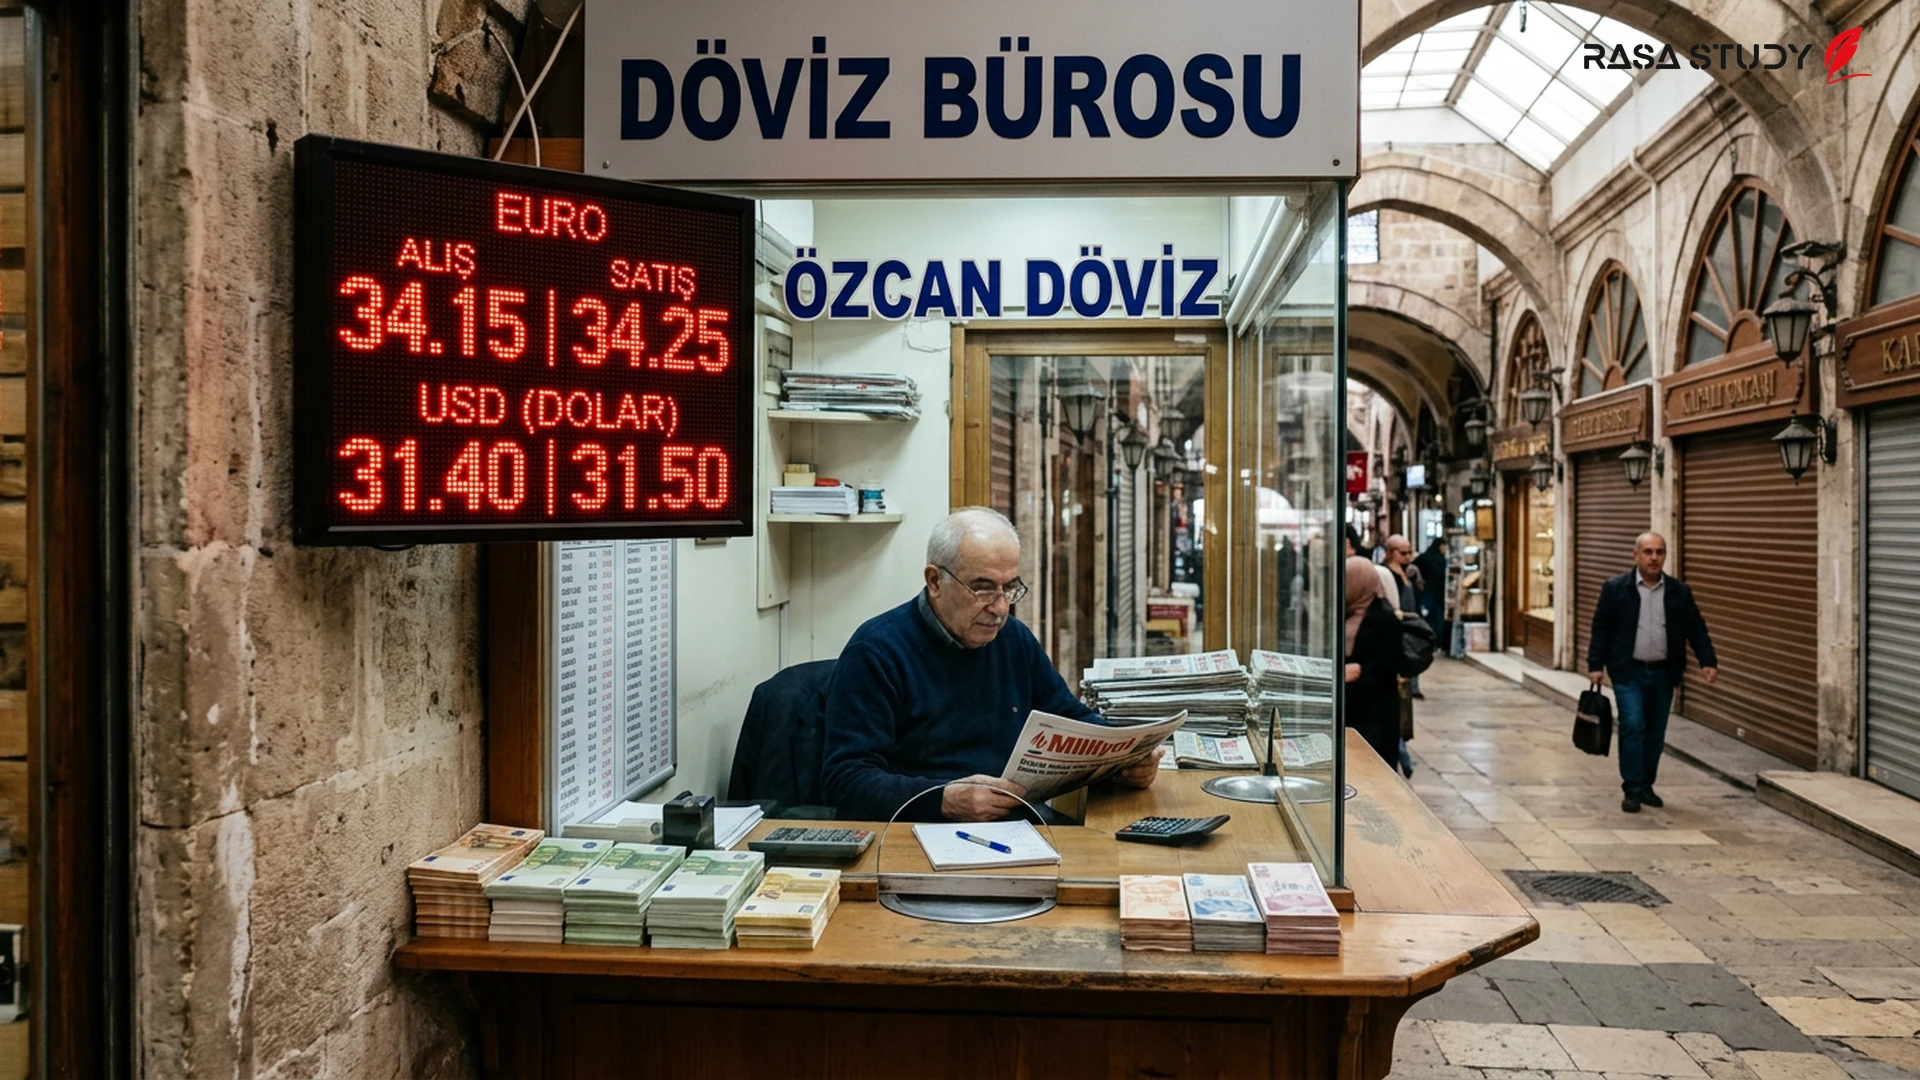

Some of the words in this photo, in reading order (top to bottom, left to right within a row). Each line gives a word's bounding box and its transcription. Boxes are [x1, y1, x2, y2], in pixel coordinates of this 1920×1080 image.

[620, 36, 891, 141] DÖVİZ
[924, 36, 1302, 140] BÜROSU
[497, 192, 607, 242] EURO
[397, 237, 476, 281] ALIŞ
[610, 259, 697, 301] SATIŞ
[786, 248, 1001, 319] ÖZCAN
[1027, 244, 1220, 318] DÖVİZ
[338, 275, 527, 361] 34.15
[572, 297, 730, 373] 34.25
[1881, 332, 1920, 371] KA
[419, 383, 506, 425] USD
[522, 388, 679, 438] (DOLAR)
[338, 437, 527, 512] 31.40
[571, 443, 729, 510] 31.50
